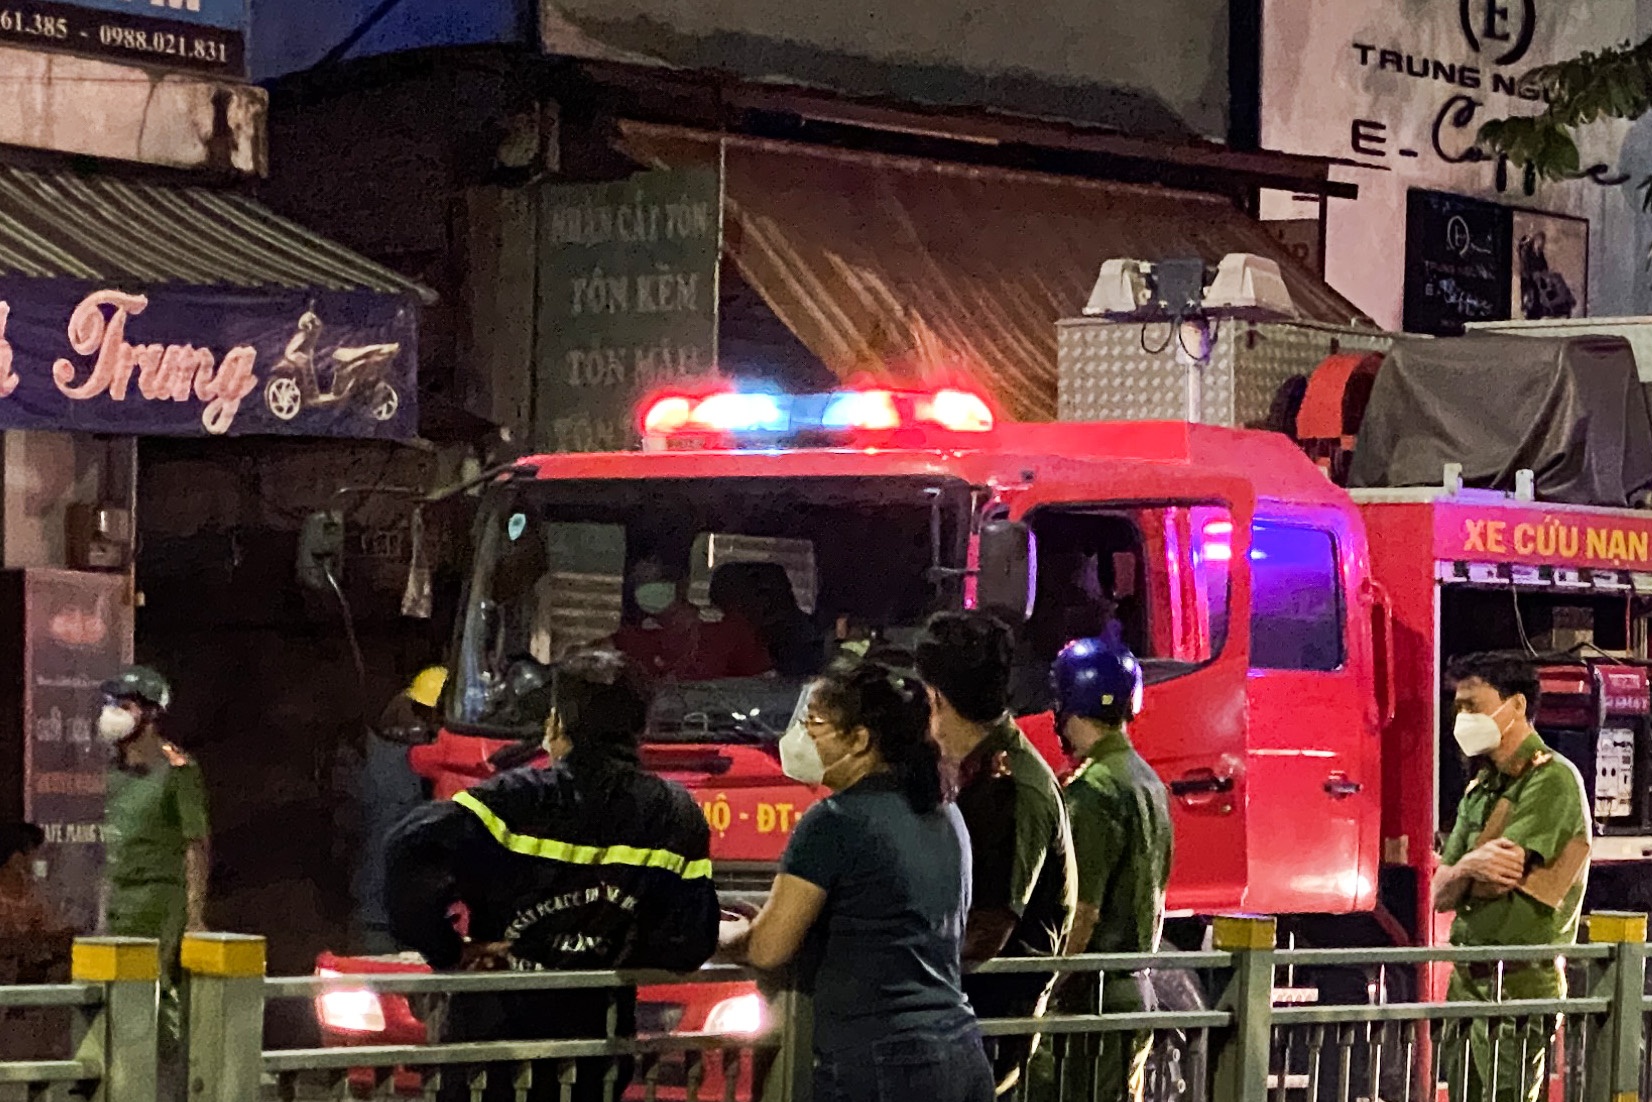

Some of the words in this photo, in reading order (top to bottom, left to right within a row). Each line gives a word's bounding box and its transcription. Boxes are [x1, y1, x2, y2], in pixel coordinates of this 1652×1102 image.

[99, 24, 228, 63] 0988.021.831
[1352, 43, 1481, 89] TRUNG
[570, 261, 629, 315] TÔN
[52, 289, 259, 435] Trung
[1464, 518, 1507, 554] XE
[1513, 514, 1579, 557] CỨU
[1586, 527, 1649, 567] NẠN
